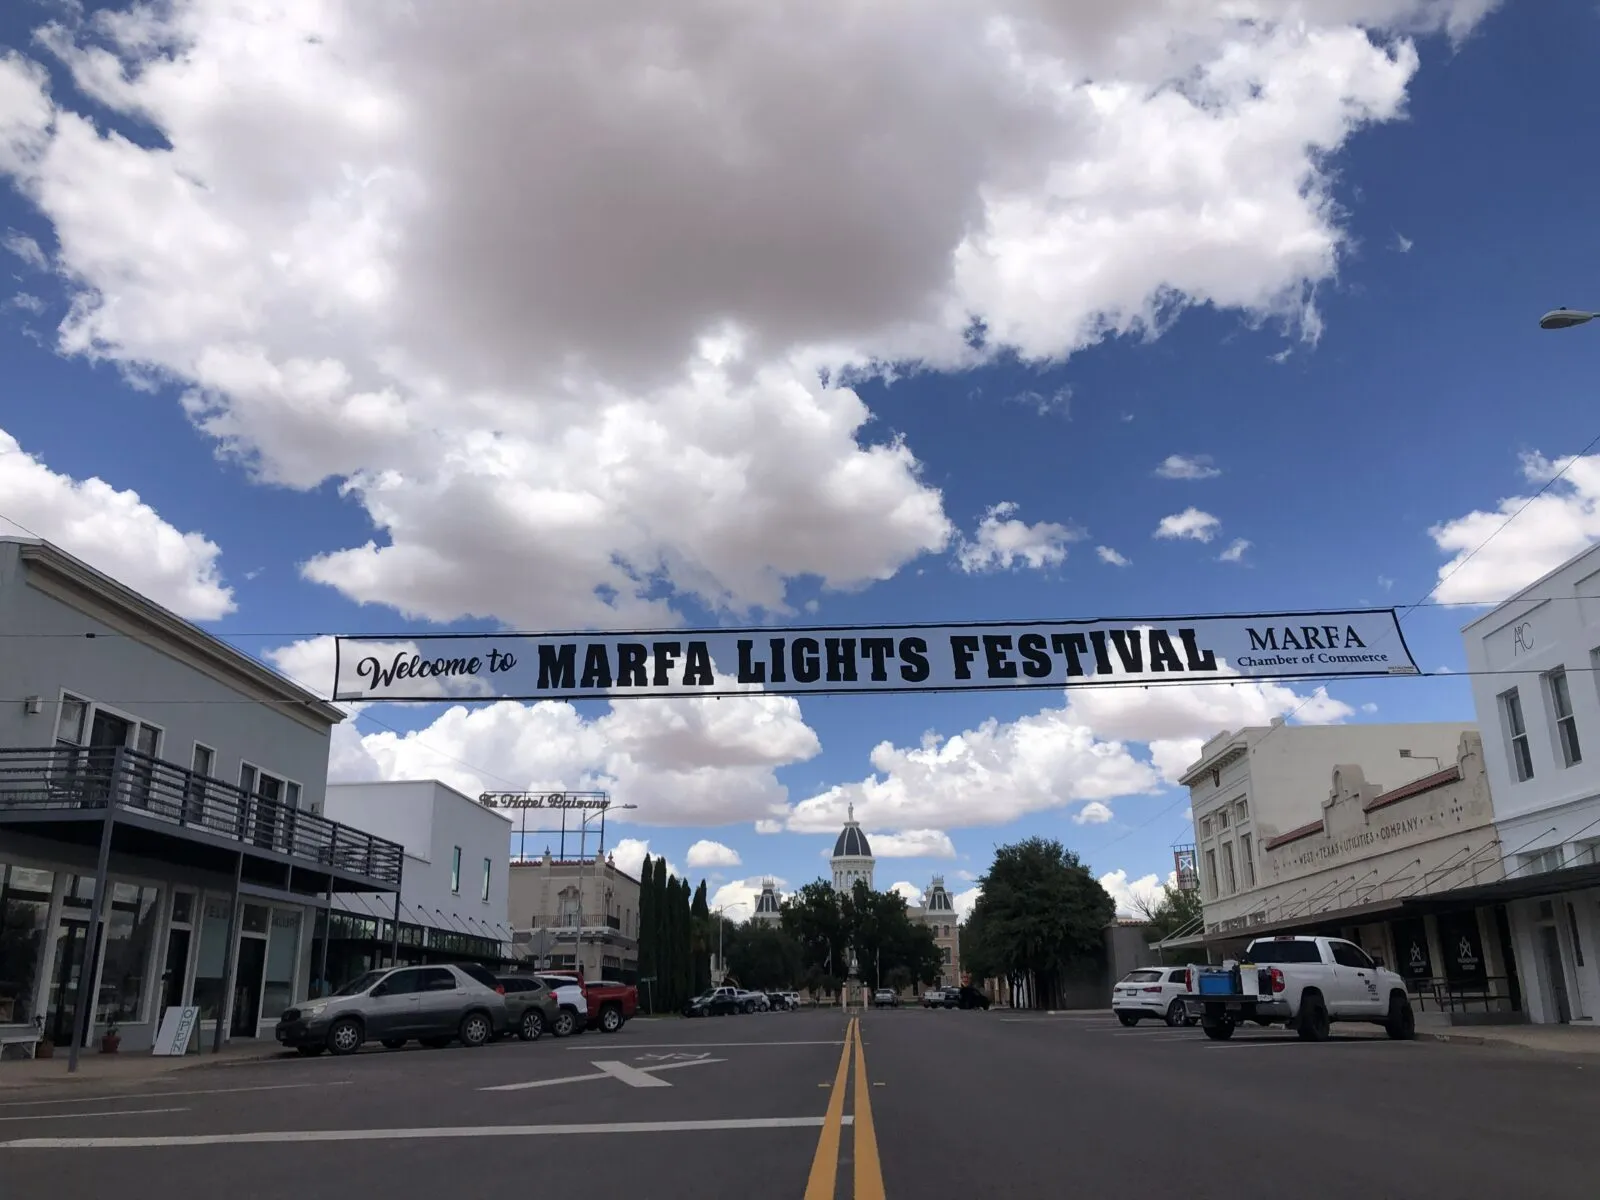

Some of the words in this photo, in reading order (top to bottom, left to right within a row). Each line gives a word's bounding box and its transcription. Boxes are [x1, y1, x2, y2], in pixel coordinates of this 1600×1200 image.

[1245, 624, 1367, 651] MARFA
[356, 651, 483, 690] Welcome
[485, 647, 517, 673] to
[537, 641, 714, 689] MARFA
[737, 636, 929, 684] LIGHTS
[949, 628, 1217, 680] FESTIVAL
[1237, 654, 1299, 667] Chamber
[1301, 653, 1315, 664] of
[1318, 652, 1389, 664] Commerce
[479, 793, 498, 809] The
[500, 793, 545, 809] Hotel
[548, 793, 611, 809] Paisano
[1299, 852, 1315, 865] WEST
[1319, 844, 1340, 860] TEXAS
[1344, 833, 1374, 851] UTILITIES
[1380, 816, 1419, 840] COMPANY
[173, 1009, 193, 1053] OPEN
